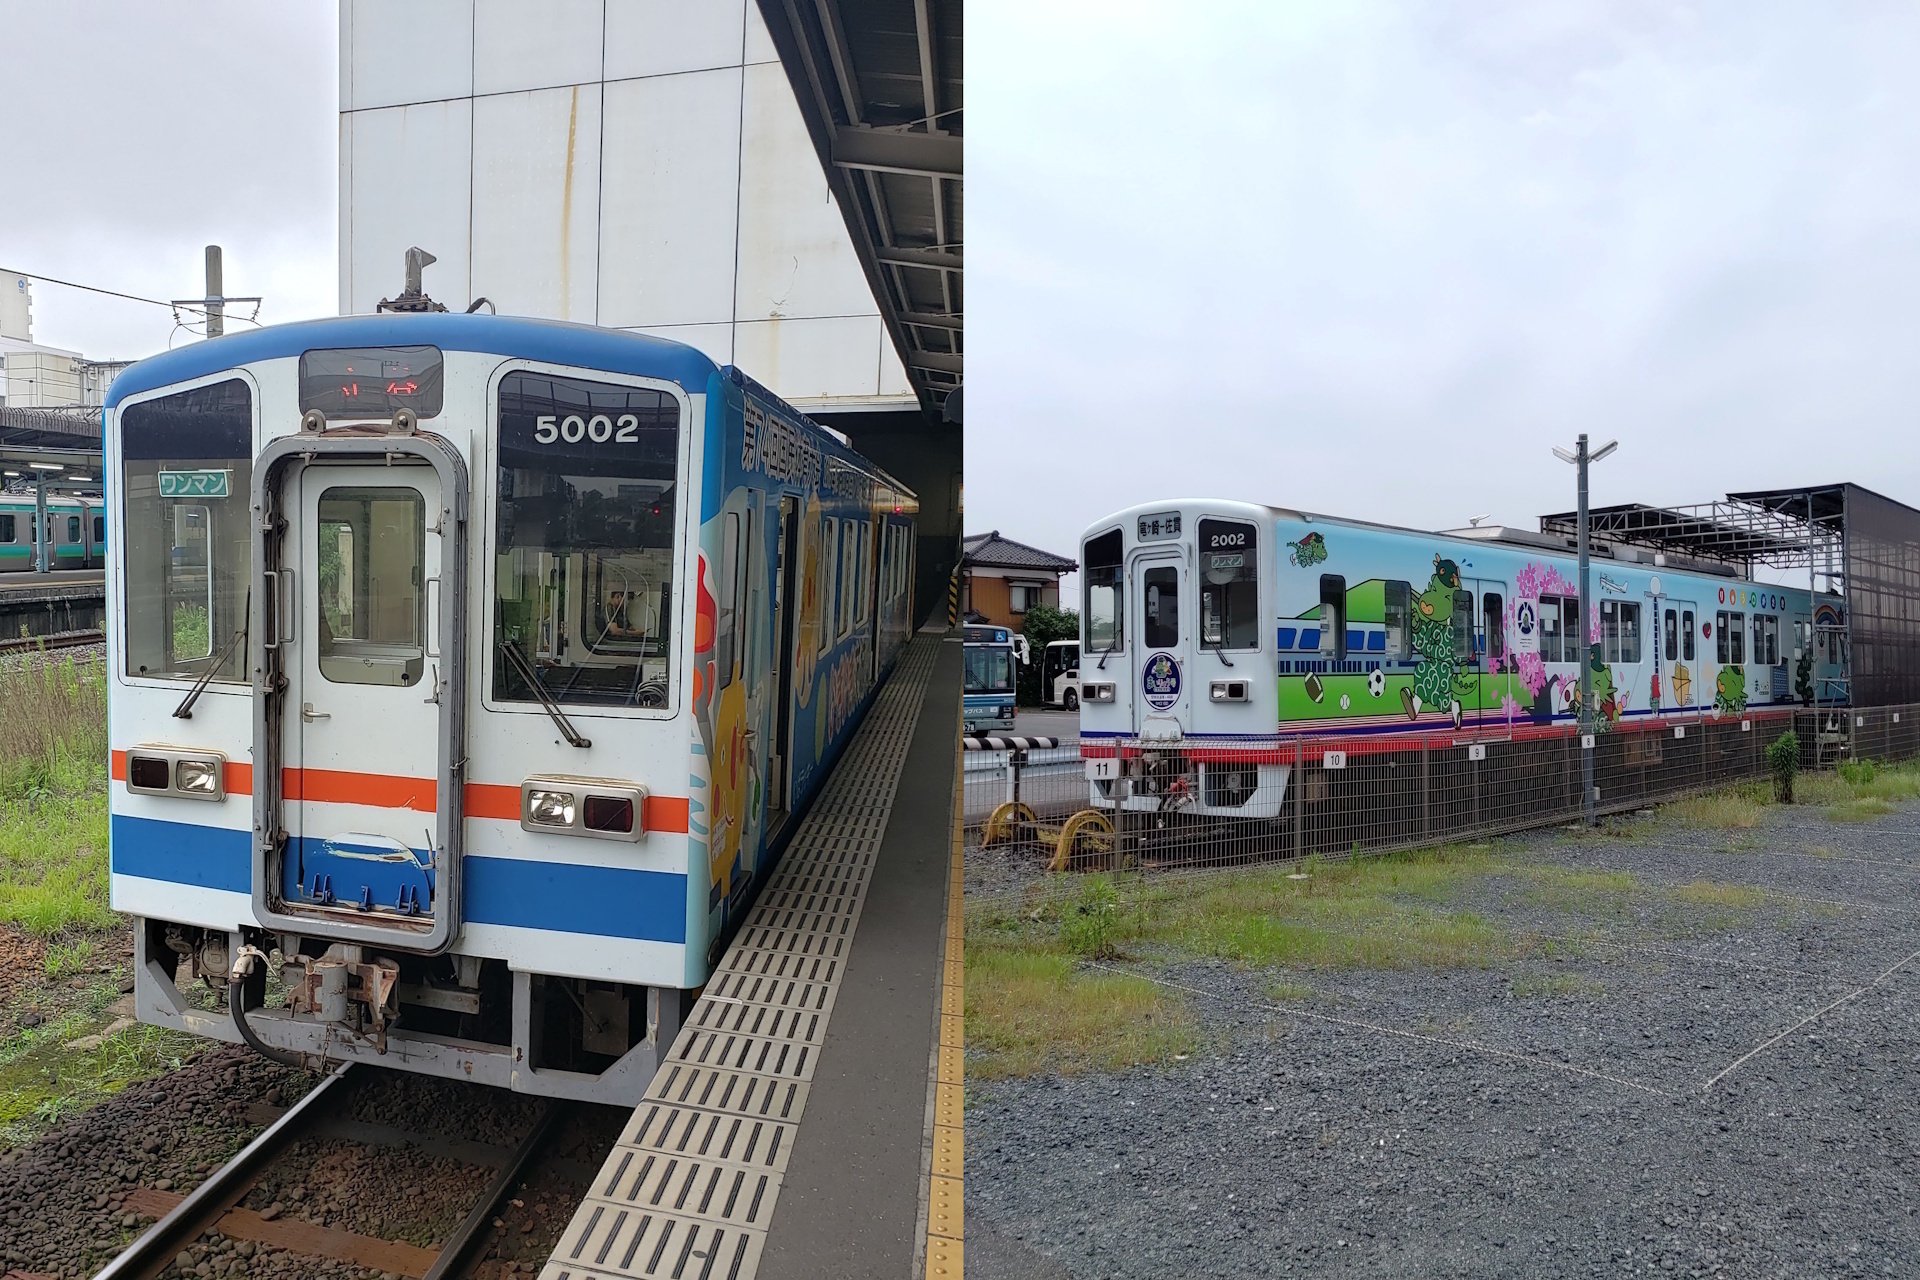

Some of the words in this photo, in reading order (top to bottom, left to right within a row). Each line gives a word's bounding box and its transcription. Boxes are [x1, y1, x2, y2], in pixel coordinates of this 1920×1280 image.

[534, 414, 640, 444] 5002
[161, 474, 226, 495] ワンマン
[1211, 533, 1246, 547] 2002
[1212, 556, 1242, 568] ワンマン
[1586, 738, 1591, 746] 8
[1475, 748, 1480, 757] 9
[1330, 755, 1340, 766] 10
[1095, 762, 1108, 776] 11
